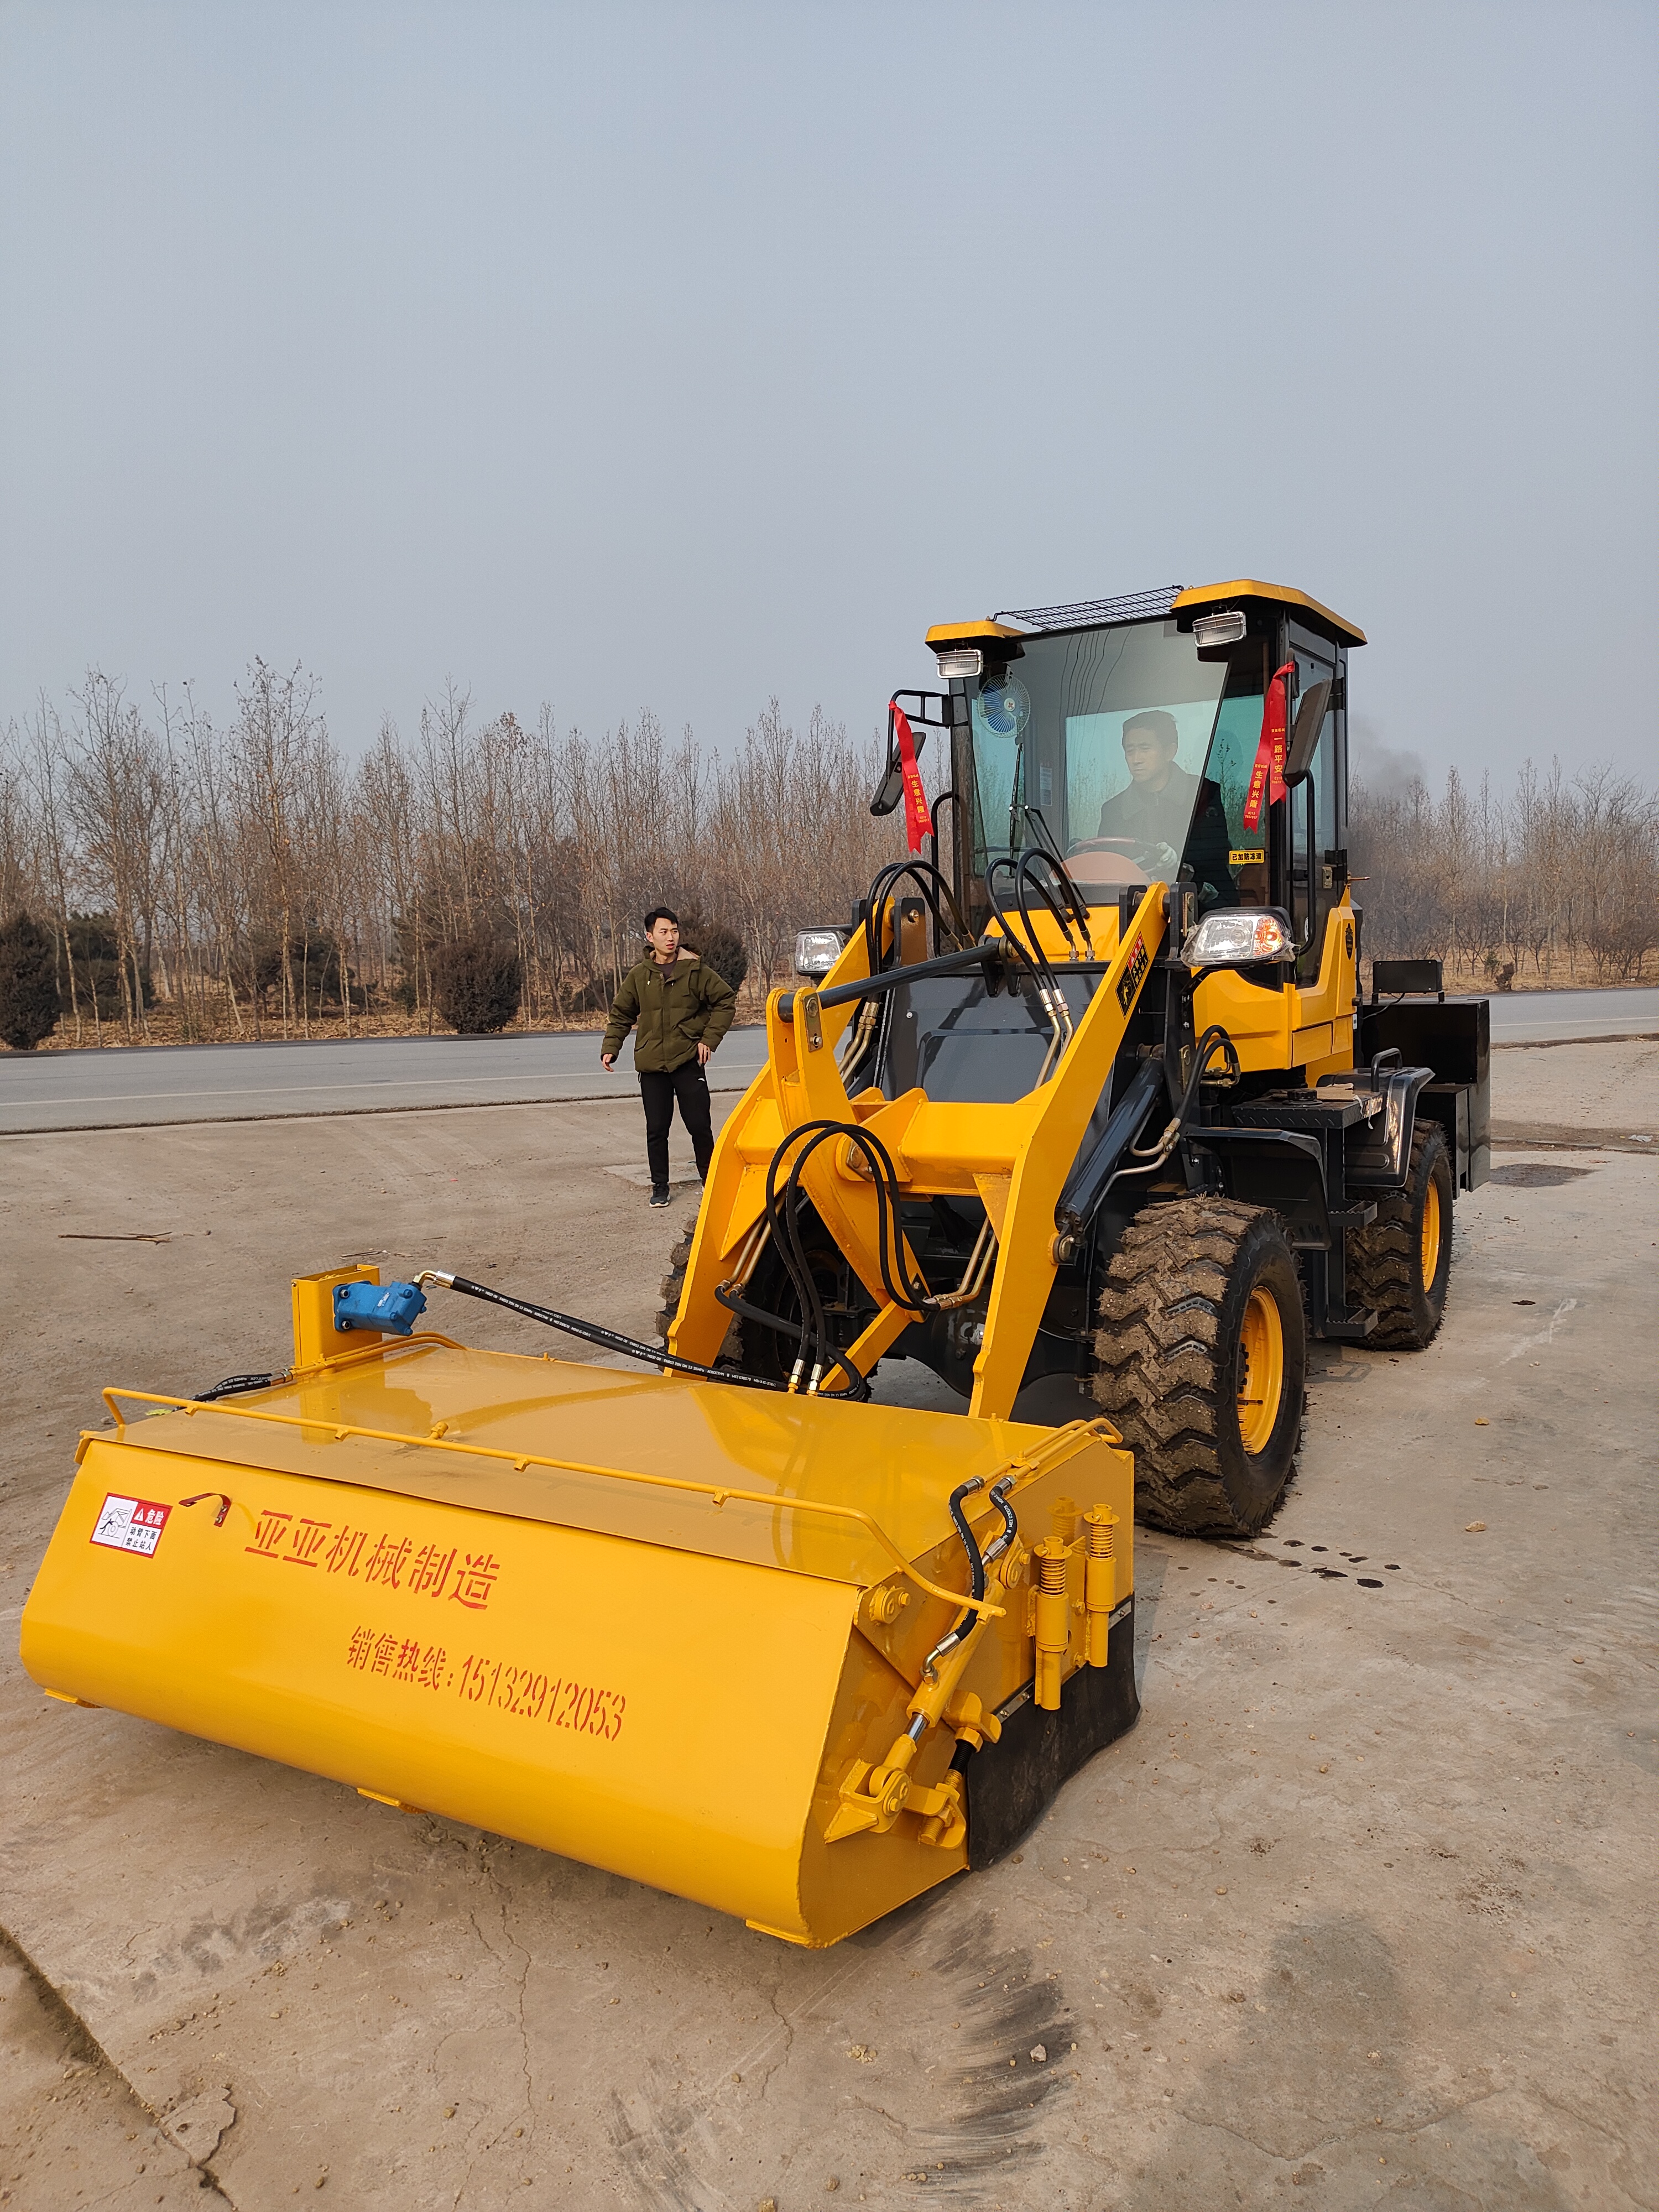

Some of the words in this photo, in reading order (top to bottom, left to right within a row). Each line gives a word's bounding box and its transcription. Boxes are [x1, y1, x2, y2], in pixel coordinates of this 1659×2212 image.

[1274, 737, 1283, 773] 一路平安
[911, 780, 925, 813] 生意兴隆
[1249, 770, 1264, 808] 生意兴隆
[1232, 852, 1262, 861] 已加防冻液
[144, 1509, 164, 1526] 危险
[125, 1537, 152, 1551] 禁止站人
[129, 1527, 158, 1540] 动臂下面
[245, 1510, 500, 1610] 亚亚机械制造
